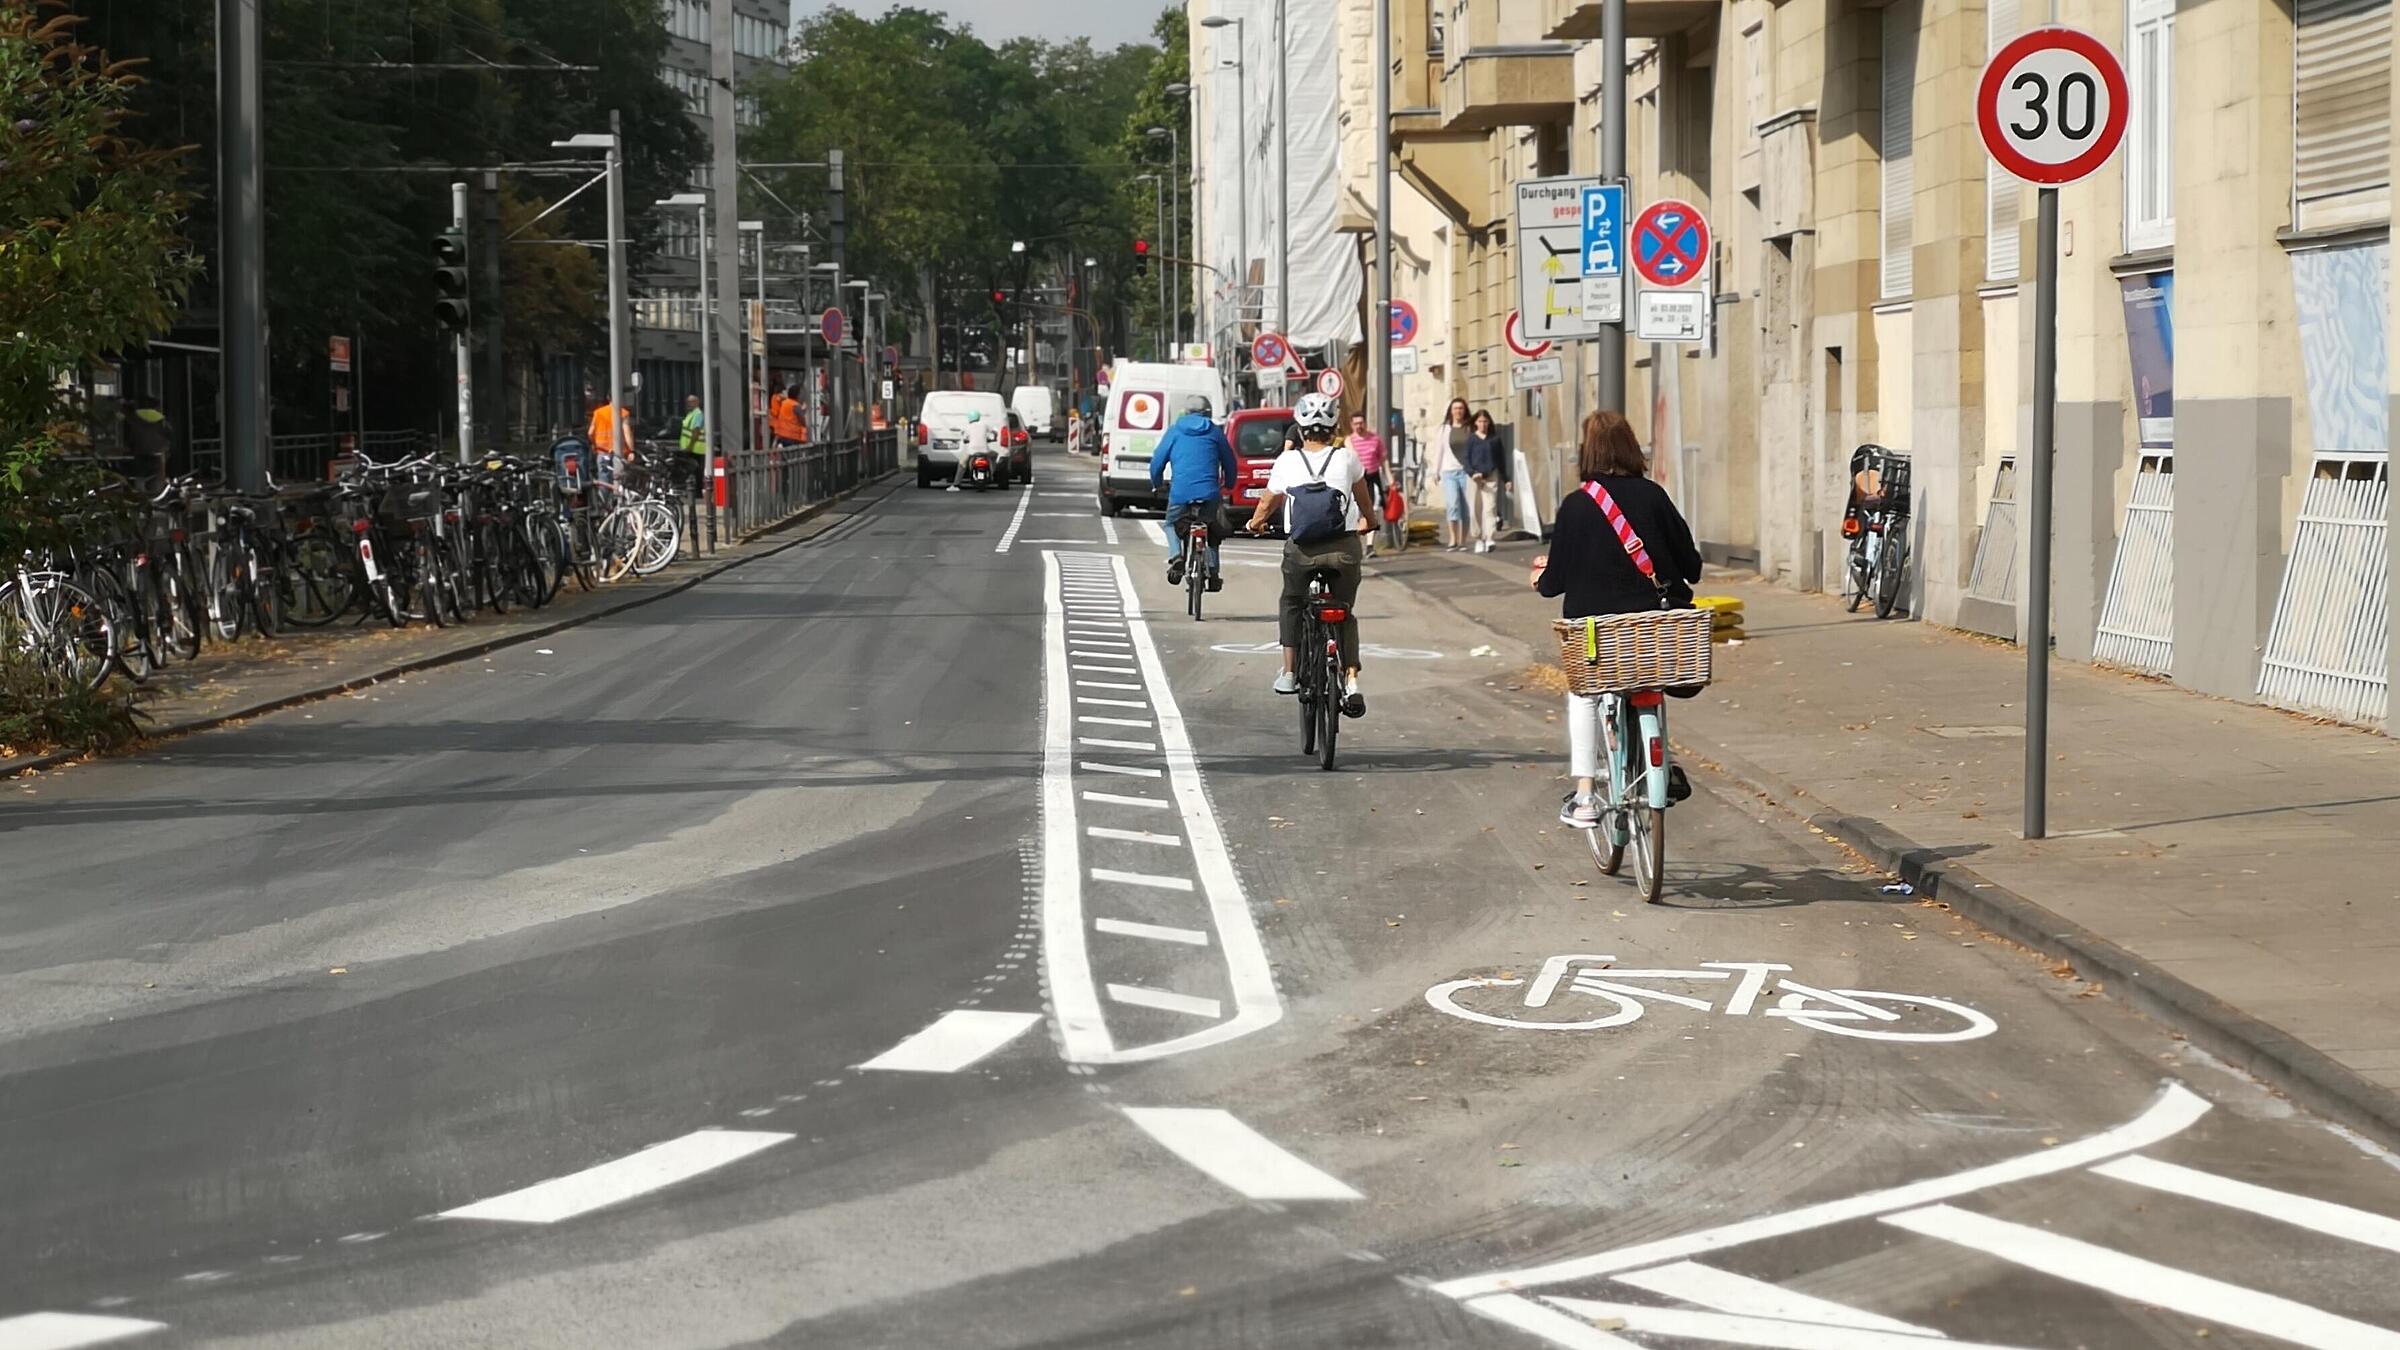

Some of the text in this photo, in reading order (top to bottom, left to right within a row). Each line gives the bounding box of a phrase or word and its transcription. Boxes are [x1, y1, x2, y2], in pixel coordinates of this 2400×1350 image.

[2010, 72, 2096, 140] 30
[1521, 186, 1575, 200] Durchgang
[1588, 193, 1606, 230] P
